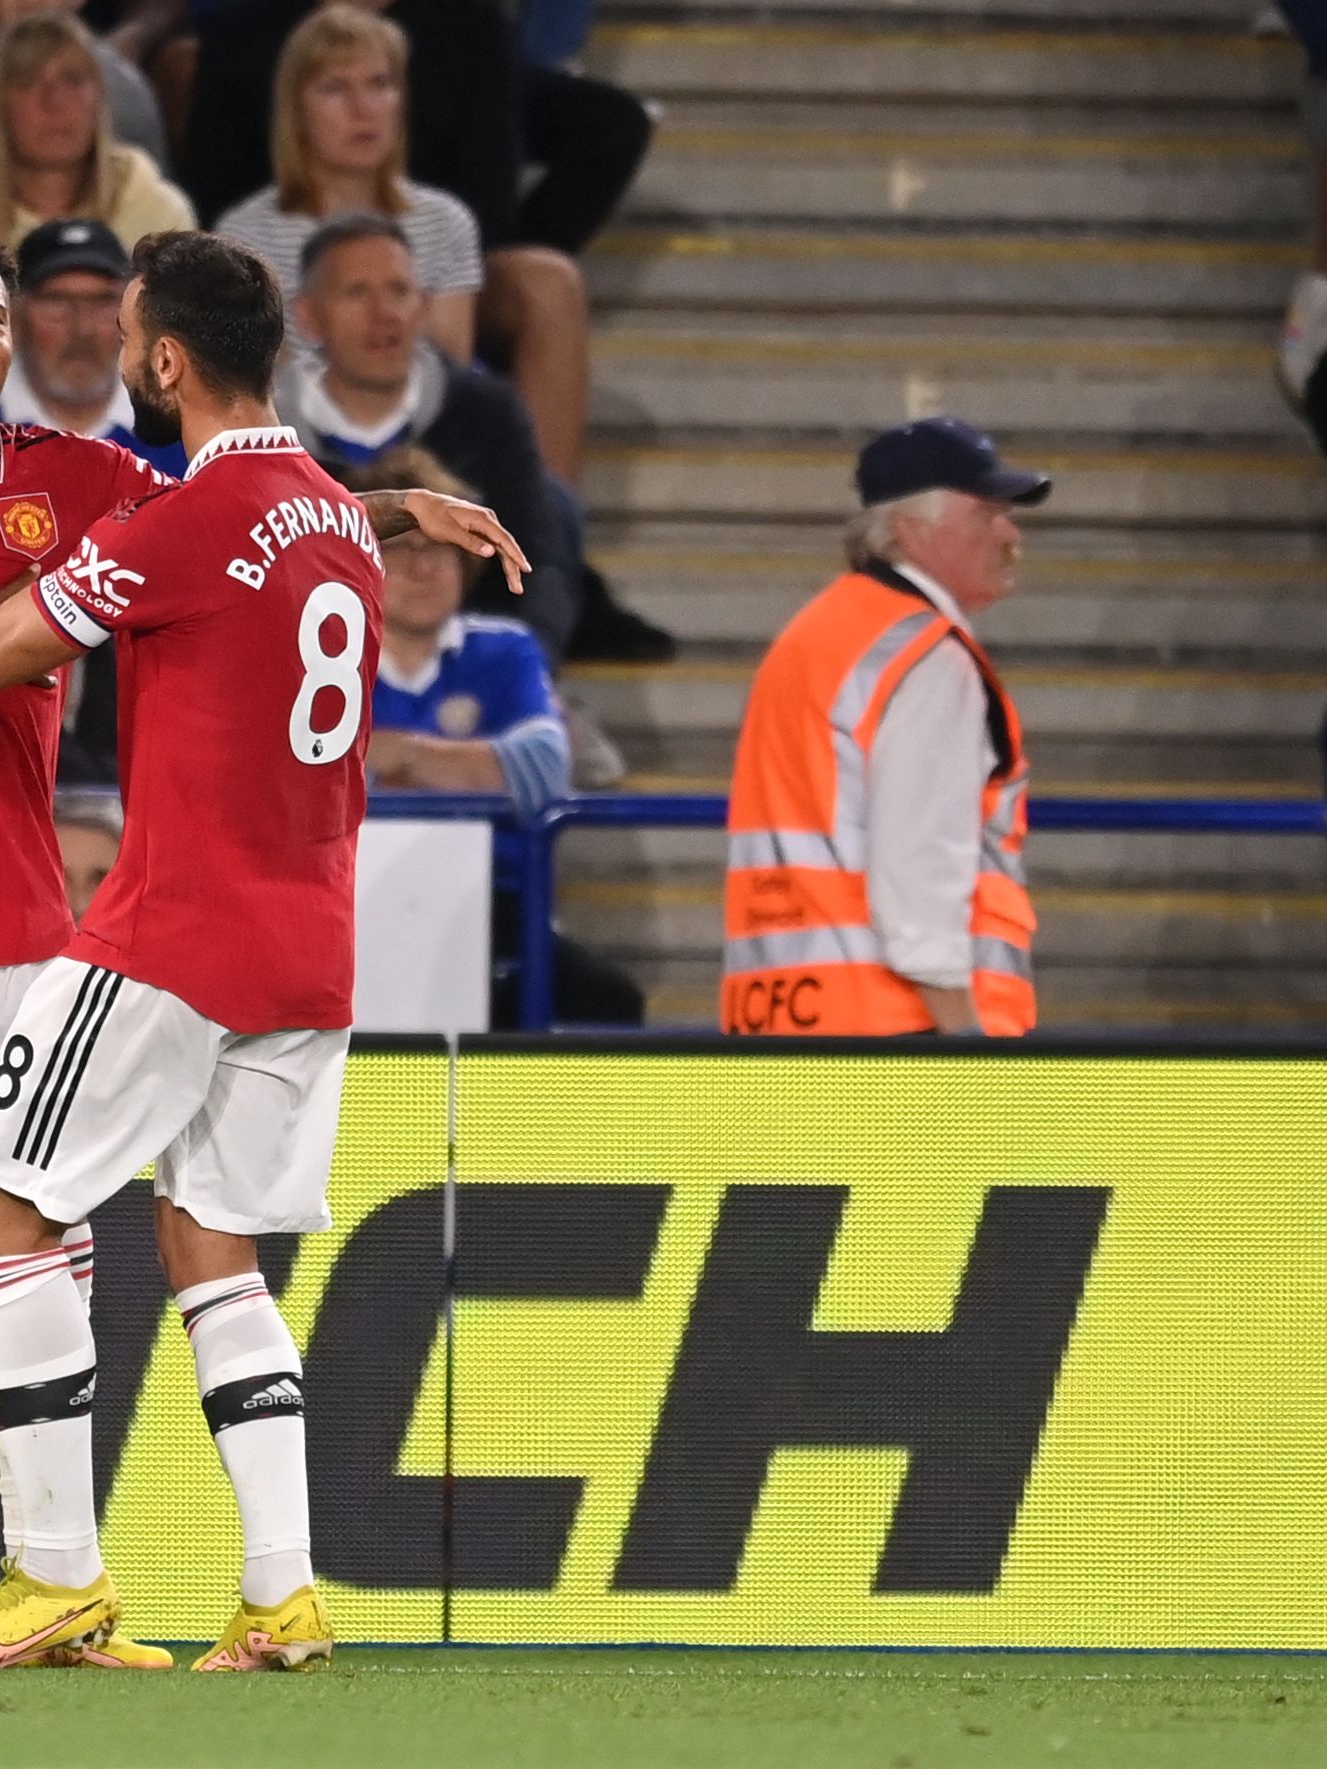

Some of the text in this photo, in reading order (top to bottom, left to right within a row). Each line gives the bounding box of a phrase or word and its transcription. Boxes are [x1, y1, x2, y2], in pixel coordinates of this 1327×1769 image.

[226, 497, 386, 588] B.FERNANDE
[42, 573, 78, 625] ptain
[56, 564, 123, 618] CHNOLOGY
[289, 581, 366, 765] 8
[242, 1393, 304, 1409] adida
